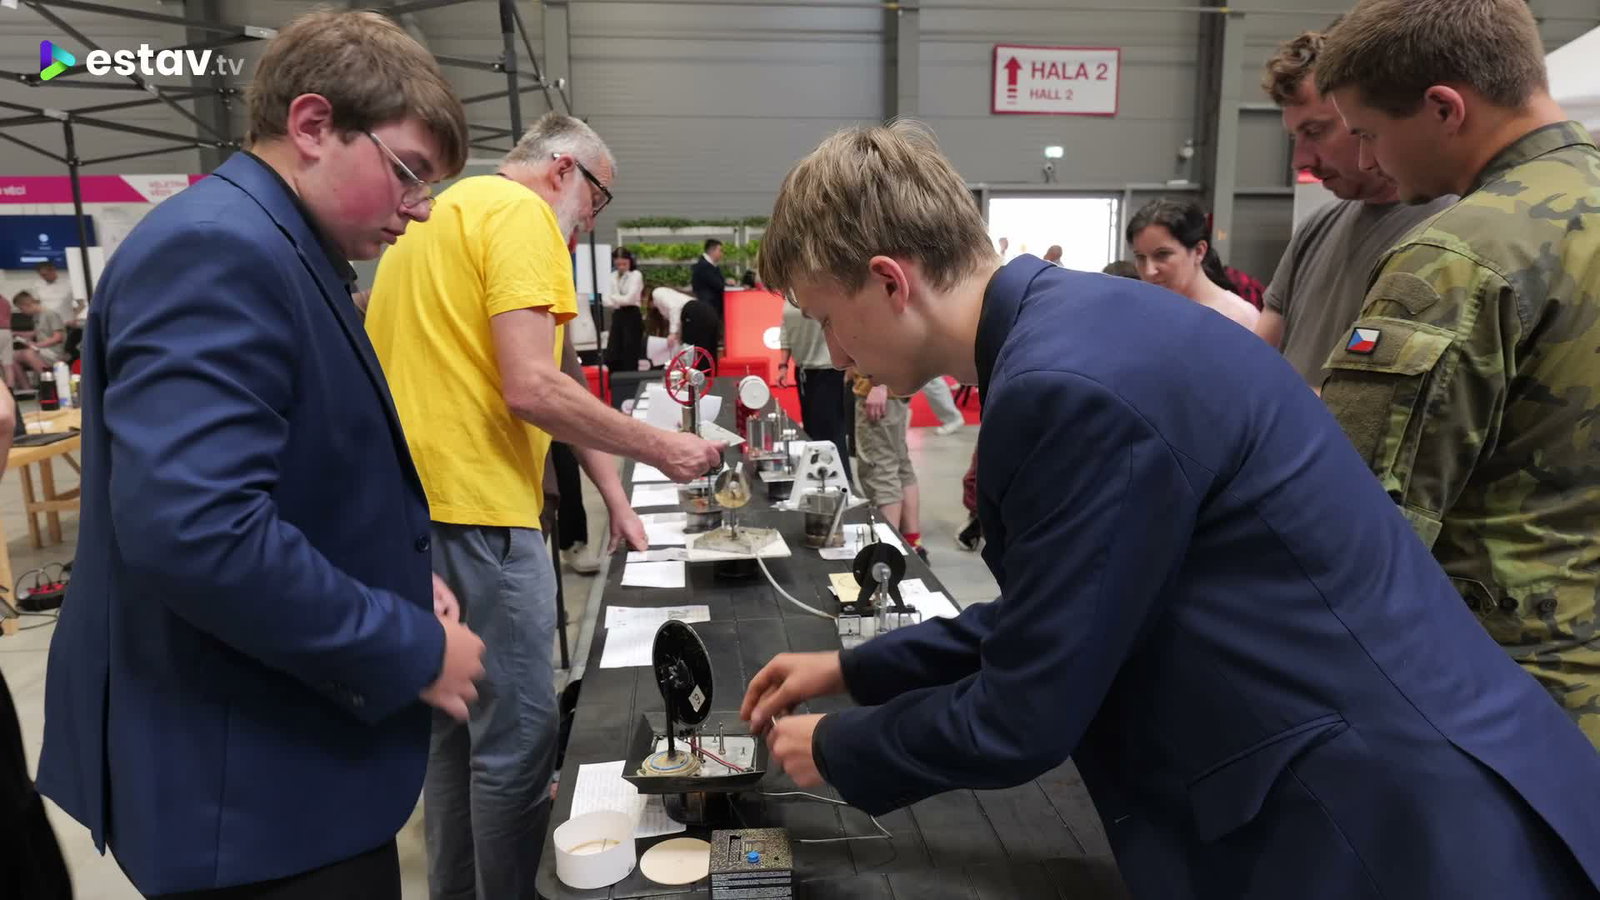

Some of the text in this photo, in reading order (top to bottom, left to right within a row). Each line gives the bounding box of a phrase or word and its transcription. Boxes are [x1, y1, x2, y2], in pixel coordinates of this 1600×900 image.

[1031, 61, 1108, 81] HALA 2
[1030, 89, 1074, 100] HALL 2
